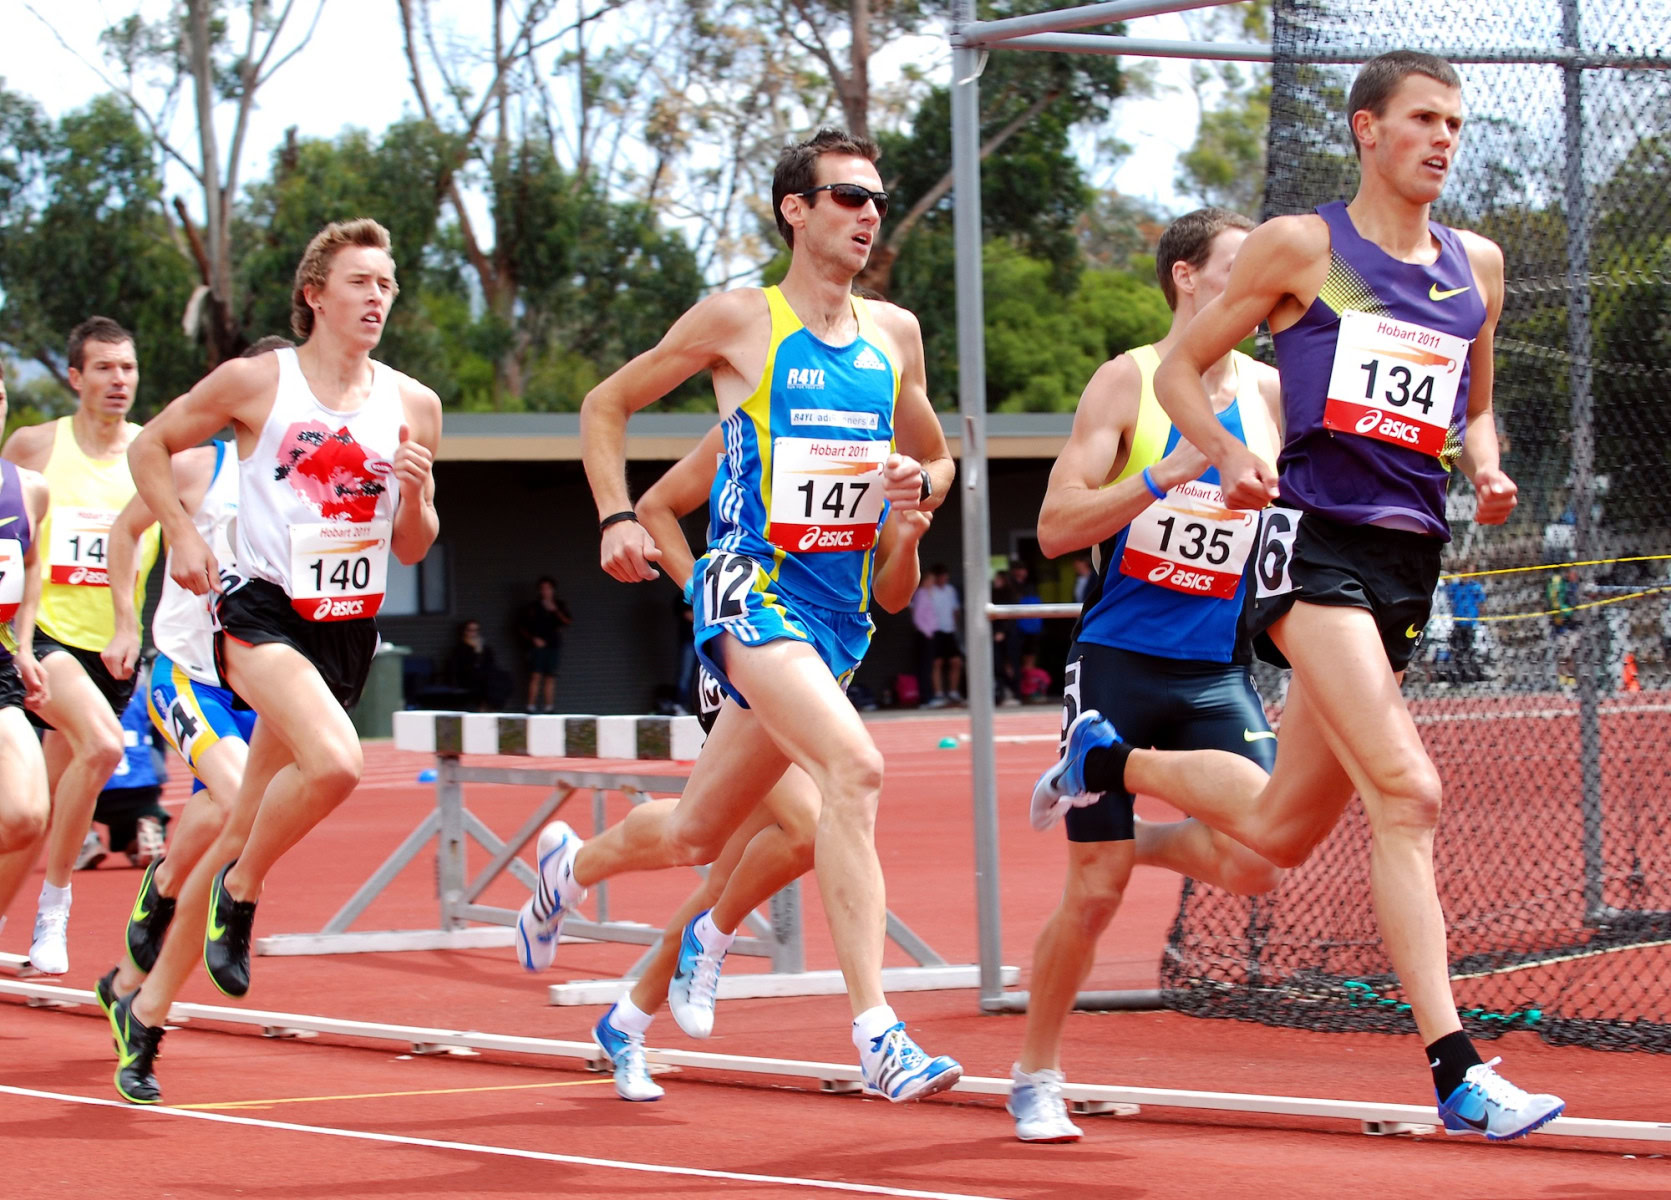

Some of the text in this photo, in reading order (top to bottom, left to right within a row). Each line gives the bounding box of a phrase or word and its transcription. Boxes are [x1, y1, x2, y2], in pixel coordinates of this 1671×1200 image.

[1376, 321, 1441, 349] Hobart 2011
[787, 368, 825, 385] R4YL
[1360, 359, 1434, 415] 134
[793, 413, 813, 422] R4YL
[809, 443, 869, 458] Hobart 2011
[797, 479, 870, 519] 147
[1176, 483, 1212, 500] Hobart
[320, 527, 351, 538] Hobart
[1157, 516, 1234, 565] 135
[69, 535, 105, 563] 14
[1258, 513, 1291, 591] 6
[310, 557, 370, 591] 140
[705, 554, 753, 621] 12
[172, 702, 198, 752] 4
